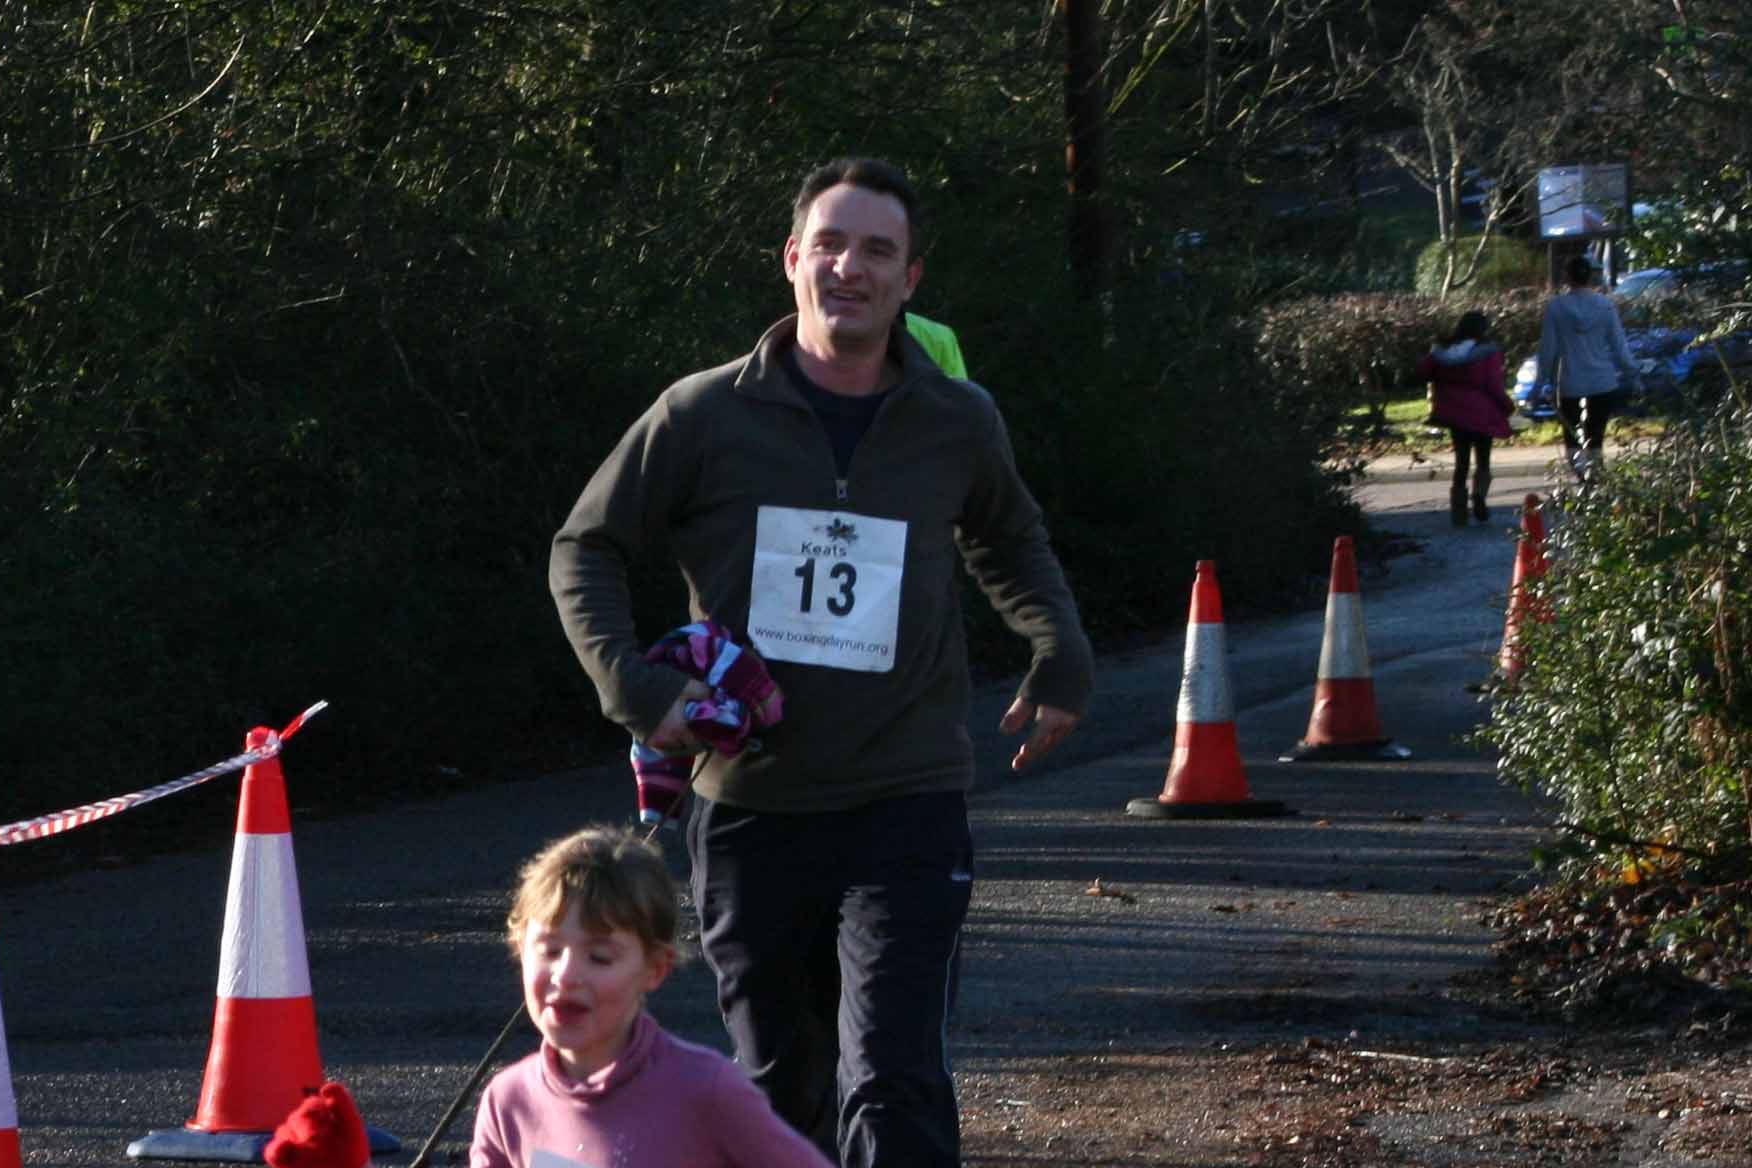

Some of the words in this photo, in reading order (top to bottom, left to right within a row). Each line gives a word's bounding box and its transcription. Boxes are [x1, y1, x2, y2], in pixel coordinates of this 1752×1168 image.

[801, 541, 847, 557] Keats
[794, 557, 857, 617] 13
[754, 626, 889, 656] www.boxingdayrun.org
